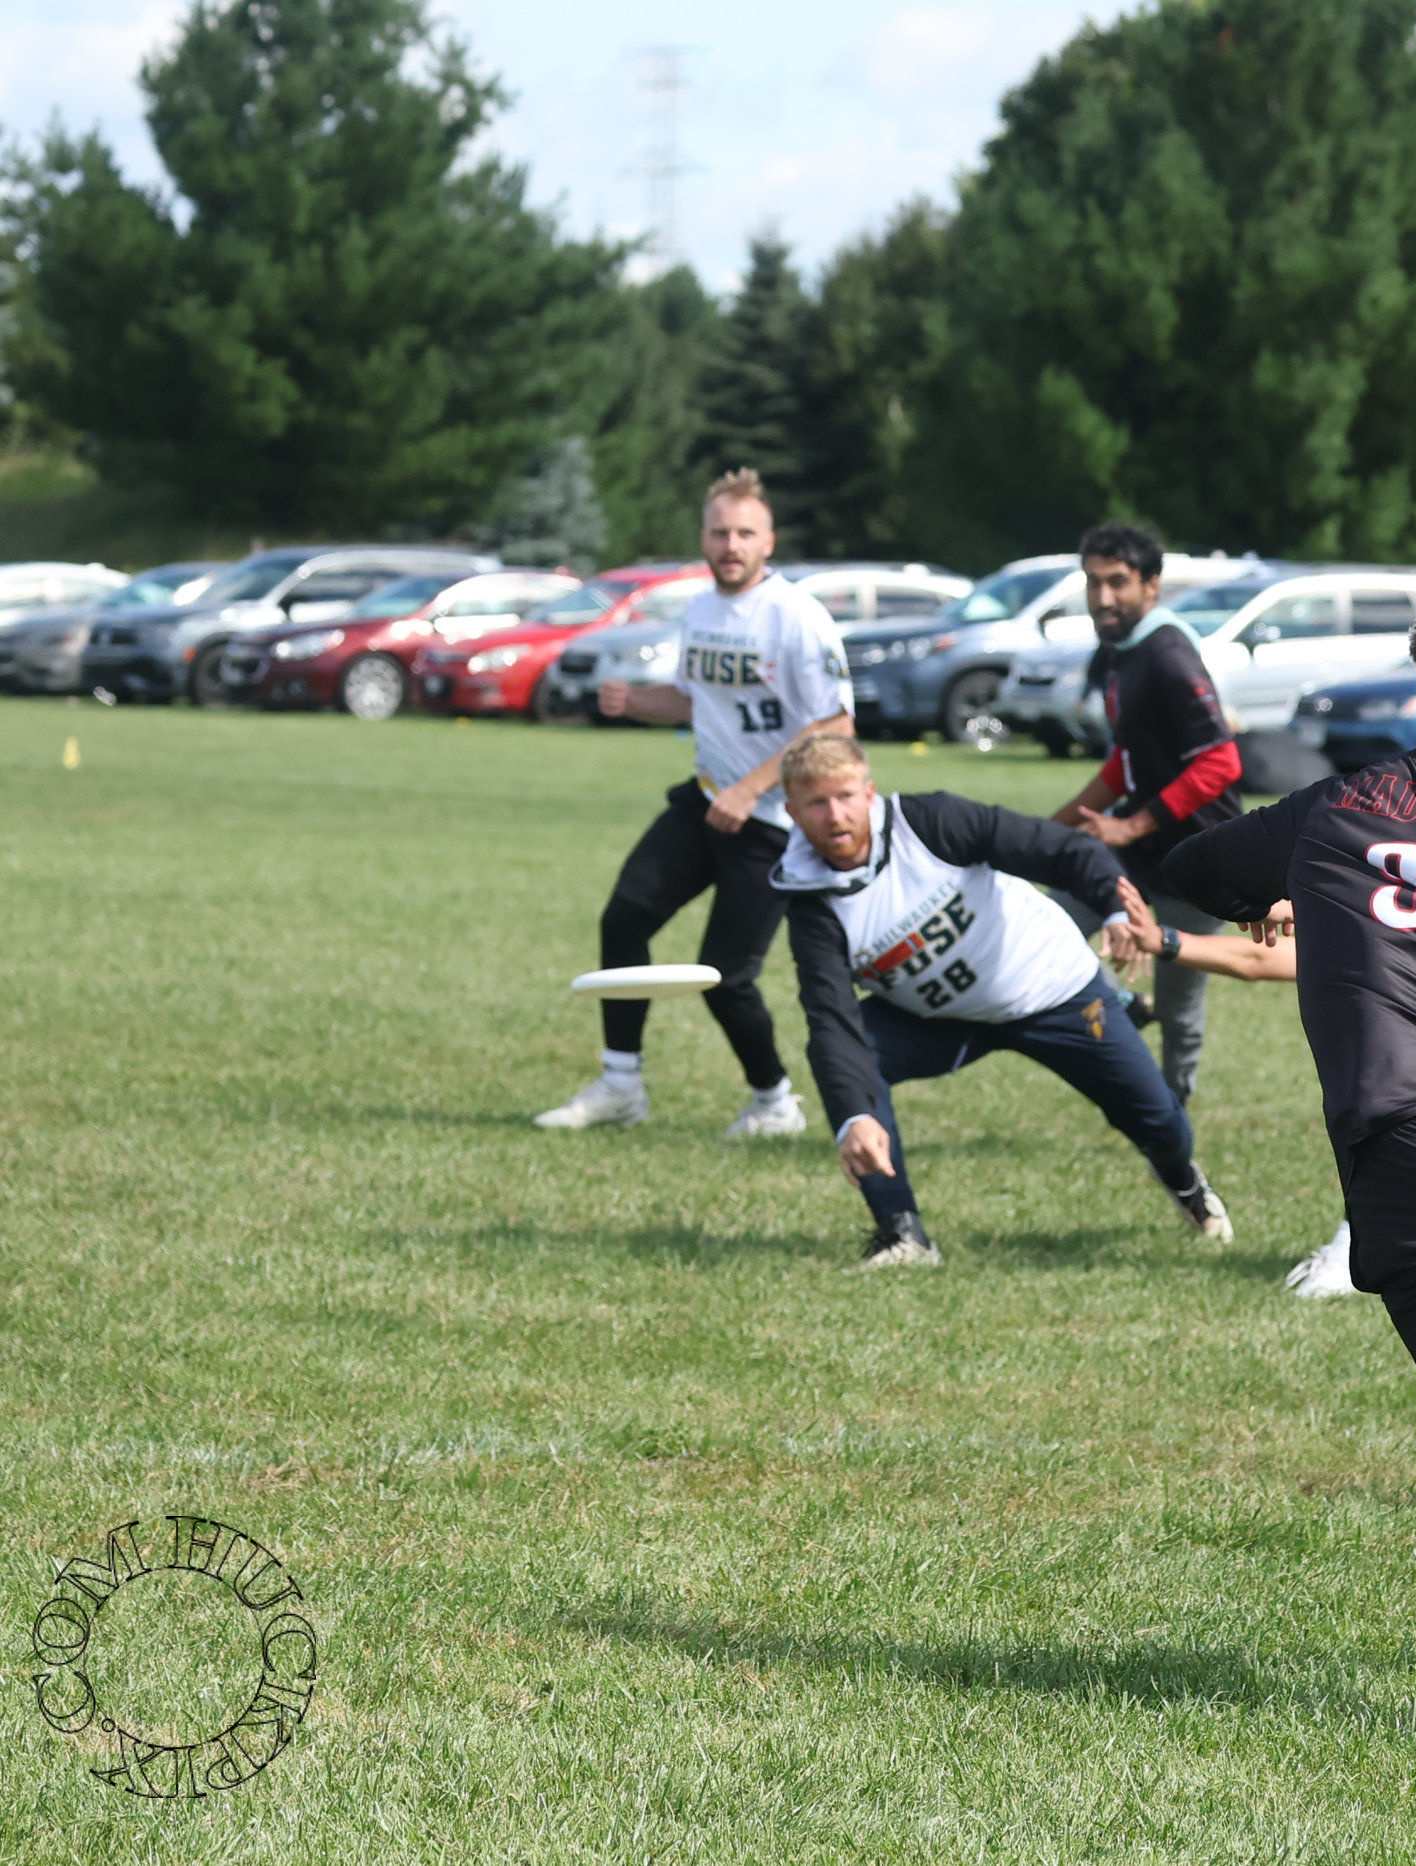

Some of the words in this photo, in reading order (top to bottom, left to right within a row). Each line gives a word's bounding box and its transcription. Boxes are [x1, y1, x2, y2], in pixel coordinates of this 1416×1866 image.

[687, 647, 764, 686] FUSE
[736, 698, 784, 733] 19
[872, 880, 956, 952] MILWAUKEE
[915, 958, 978, 1011] 28
